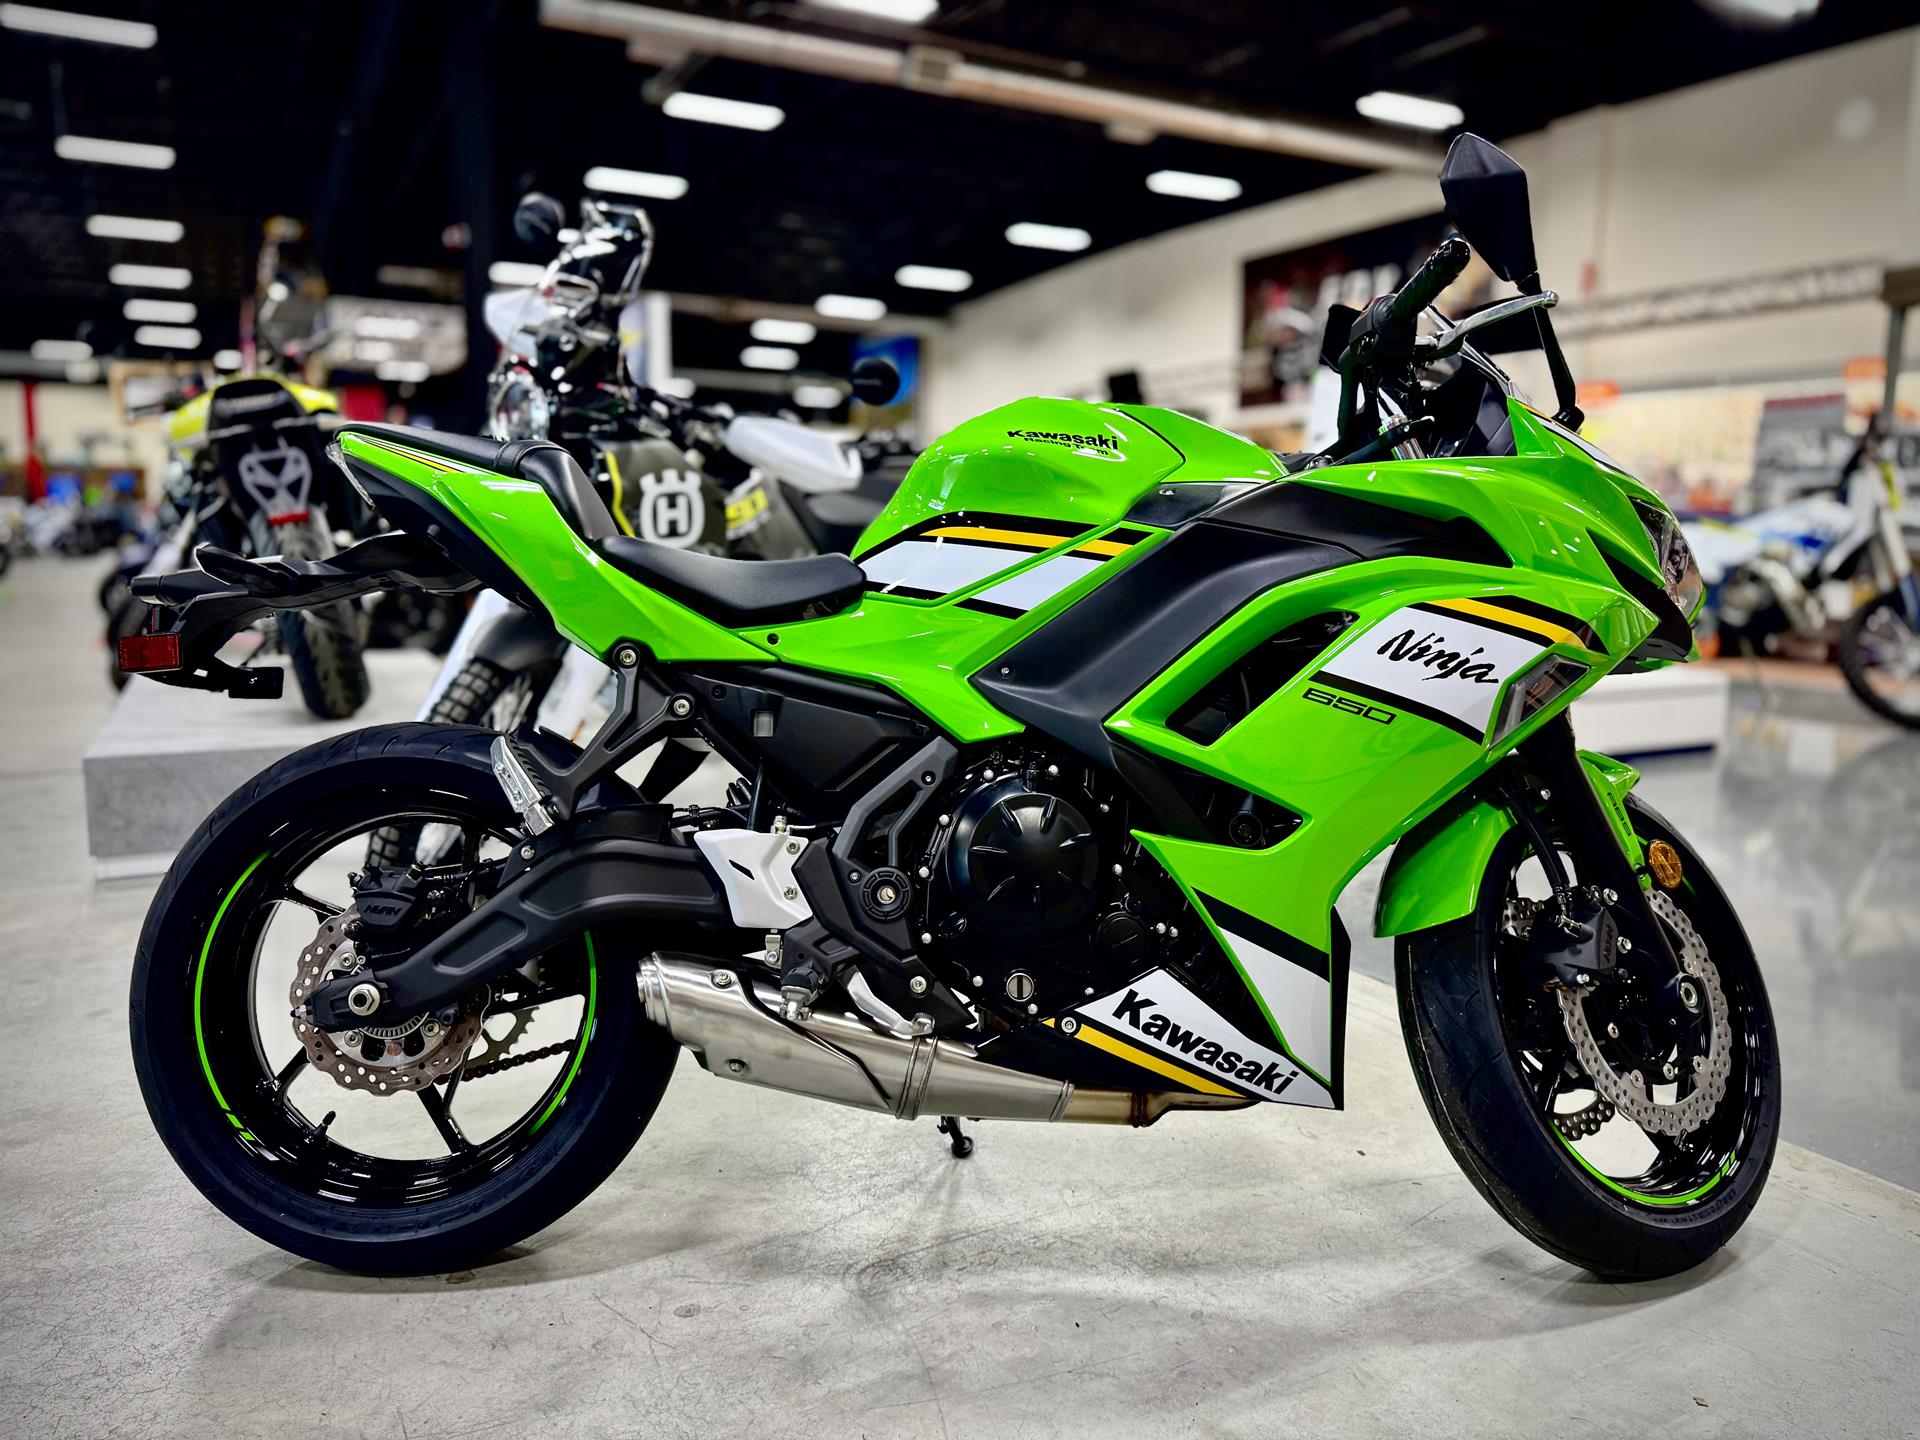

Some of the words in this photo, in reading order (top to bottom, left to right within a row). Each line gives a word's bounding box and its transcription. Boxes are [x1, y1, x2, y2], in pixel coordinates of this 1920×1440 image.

[1006, 430, 1119, 450] Kawasaki
[1023, 437, 1072, 448] Racing
[1376, 629, 1499, 684] Ninja
[1302, 687, 1397, 725] 650
[1111, 988, 1300, 1095] Kawasaki
